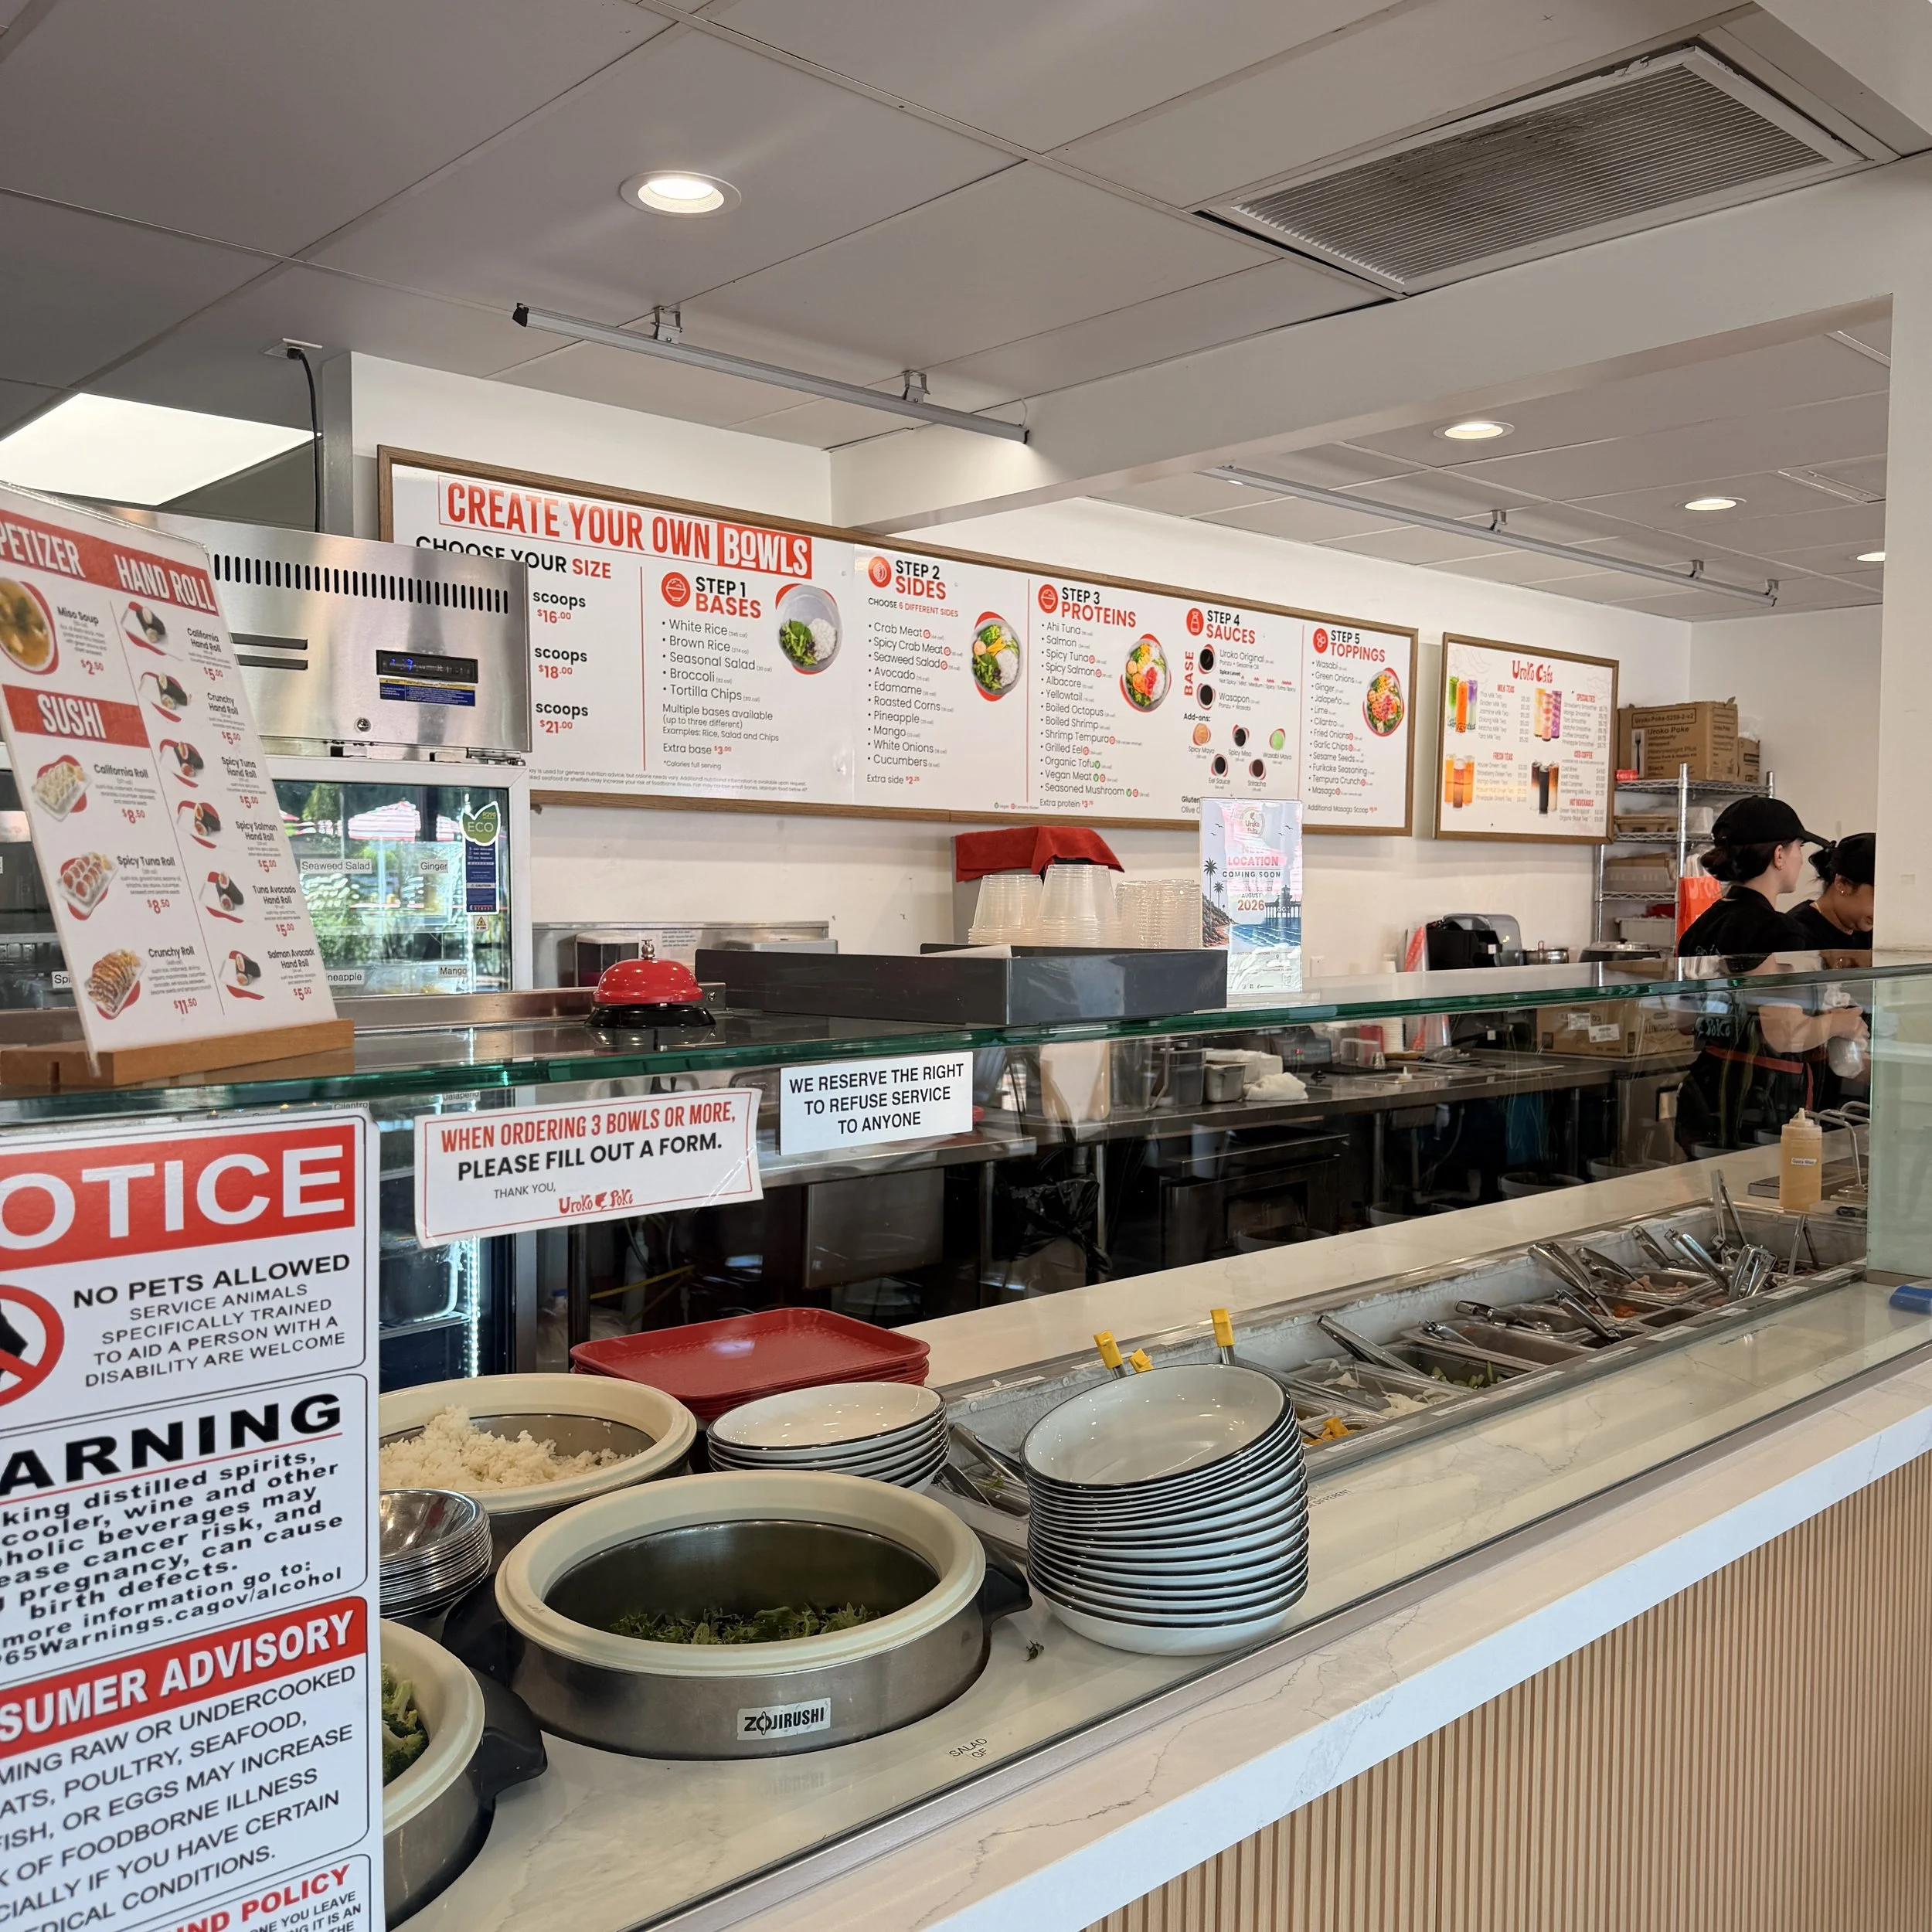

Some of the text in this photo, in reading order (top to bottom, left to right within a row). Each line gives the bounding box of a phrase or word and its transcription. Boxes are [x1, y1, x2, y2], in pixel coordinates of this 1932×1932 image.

[447, 481, 808, 577] CREATE YOUR OWN BOWLS
[416, 536, 612, 580] CHOOSE YOUR SIZE
[896, 560, 940, 580] STEP 2
[114, 554, 216, 612] HAND ROLL
[696, 577, 747, 597] STEP 1
[896, 576, 946, 600] SIDES
[533, 590, 586, 608] scoops
[1062, 587, 1100, 604] STEP 3
[696, 595, 761, 619] BASES
[868, 597, 897, 608] CHOOSE
[905, 603, 938, 615] DIFFERENT
[940, 608, 958, 617] SIDES
[1062, 601, 1136, 628] PROTEINS
[57, 607, 99, 626] Miso Soup
[1208, 611, 1240, 626] STEP 4
[669, 619, 727, 636] White Rice
[874, 622, 922, 638] Crab Meat
[1046, 622, 1080, 634] Ahi Tuna
[1206, 624, 1255, 644] SAUCES
[669, 635, 730, 652] Brown Rice
[1046, 635, 1077, 647] Salmon
[1331, 630, 1359, 644] STEP 5
[535, 646, 588, 663] scoops
[1331, 642, 1385, 662] TOPPINGS
[670, 652, 755, 670] Seasonal Salad
[1316, 660, 1338, 669] Wasabi
[670, 668, 715, 683] Broccoli
[874, 667, 915, 680] Avocado
[1046, 676, 1081, 688] Albacore
[1184, 651, 1194, 696] BASE
[1315, 672, 1354, 683] Green Onions
[670, 685, 742, 702] Tortilla Chips
[874, 682, 922, 695] Edamame
[1046, 689, 1082, 701] Yellowtail
[536, 702, 589, 717] scoops
[874, 696, 940, 711] Roasted Corns
[1046, 702, 1104, 717] Boiled Octopus
[37, 694, 107, 739] SUSHI
[874, 711, 920, 726] Pineapple
[1184, 713, 1210, 722] Add-ons:
[874, 726, 906, 739] Mango
[663, 743, 685, 753] Extra
[688, 744, 712, 754] base
[874, 740, 934, 753] White Onions
[1046, 743, 1082, 754] Grilled Eel
[873, 755, 927, 767] Cucumbers
[94, 764, 148, 779] California Roll
[867, 774, 903, 784] Extra side
[467, 821, 494, 833] ECO
[301, 861, 370, 871] Seaweed Salad
[420, 861, 447, 872] Ginger
[1228, 856, 1278, 866] LOCATION
[1237, 900, 1264, 911] 2026
[148, 946, 195, 960] Crunchy Roll
[440, 966, 467, 978] Mango
[790, 1063, 964, 1094] WE RESERVE THE RIGHT
[804, 1087, 951, 1116] TO REFUSE SERVICE
[441, 1102, 736, 1153] WHEN ORDERING 3 BOWLS OR MORE,
[838, 1111, 921, 1135] TO ANYONE
[457, 1132, 722, 1182] PLEASE FILL OUT A FORM.
[494, 1182, 556, 1199] THANK YOU,
[73, 1253, 350, 1308] NO PETS ALLOWED
[129, 1284, 308, 1321] SERVICE ANIMALS
[102, 1299, 332, 1345] SPECIFICALLY TRAINED
[94, 1316, 338, 1366] TO AID A PERSON WITH A
[85, 1333, 345, 1386] DISABILITY ARE WELCOME
[83, 1452, 315, 1510] distilled spirits,
[30, 1563, 238, 1620] birth defects.
[83, 1561, 311, 1625] information go to:
[159, 1611, 353, 1696] ADVISORY
[743, 1707, 825, 1736] ZOJIRUSHI
[63, 1711, 307, 1798] POULTRY, SEAFOOD,
[948, 1737, 988, 1758] SALAD
[971, 1747, 988, 1760] GF
[61, 1768, 318, 1867] FOODBORNE ILLNESS
[122, 1845, 276, 1910] CONDITIONS.
[241, 1865, 350, 1922] POLICY
